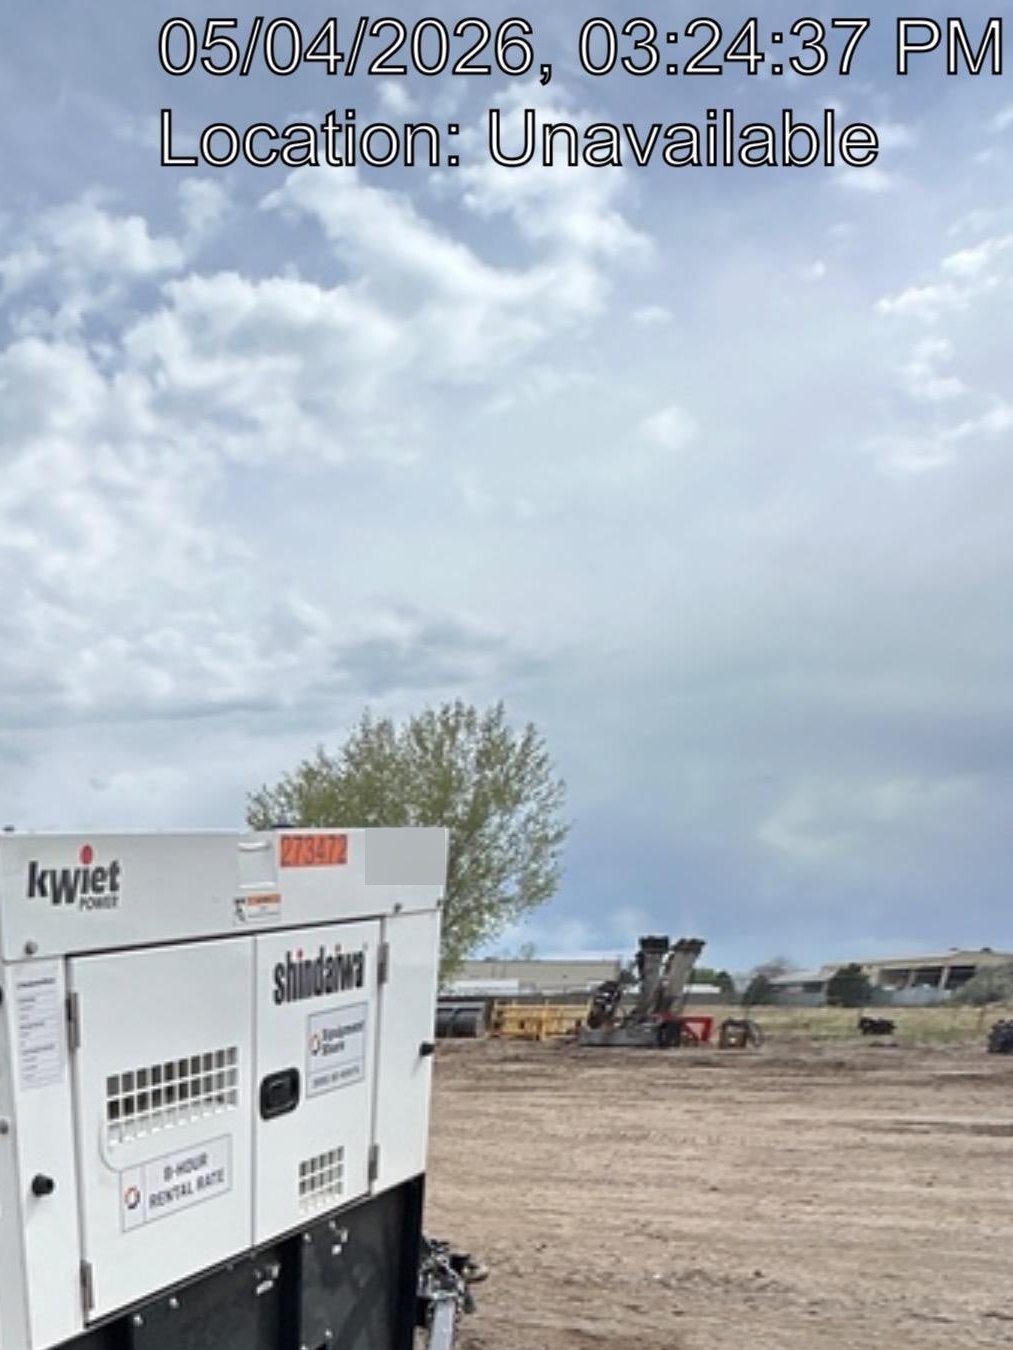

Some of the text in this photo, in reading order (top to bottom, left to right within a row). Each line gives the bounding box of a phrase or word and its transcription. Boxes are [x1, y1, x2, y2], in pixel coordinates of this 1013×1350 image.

[27, 844, 120, 906] kwiet
[280, 835, 348, 867] 273472
[273, 943, 365, 1006] shindaiwa
[149, 1166, 224, 1210] RENTAL RATE
